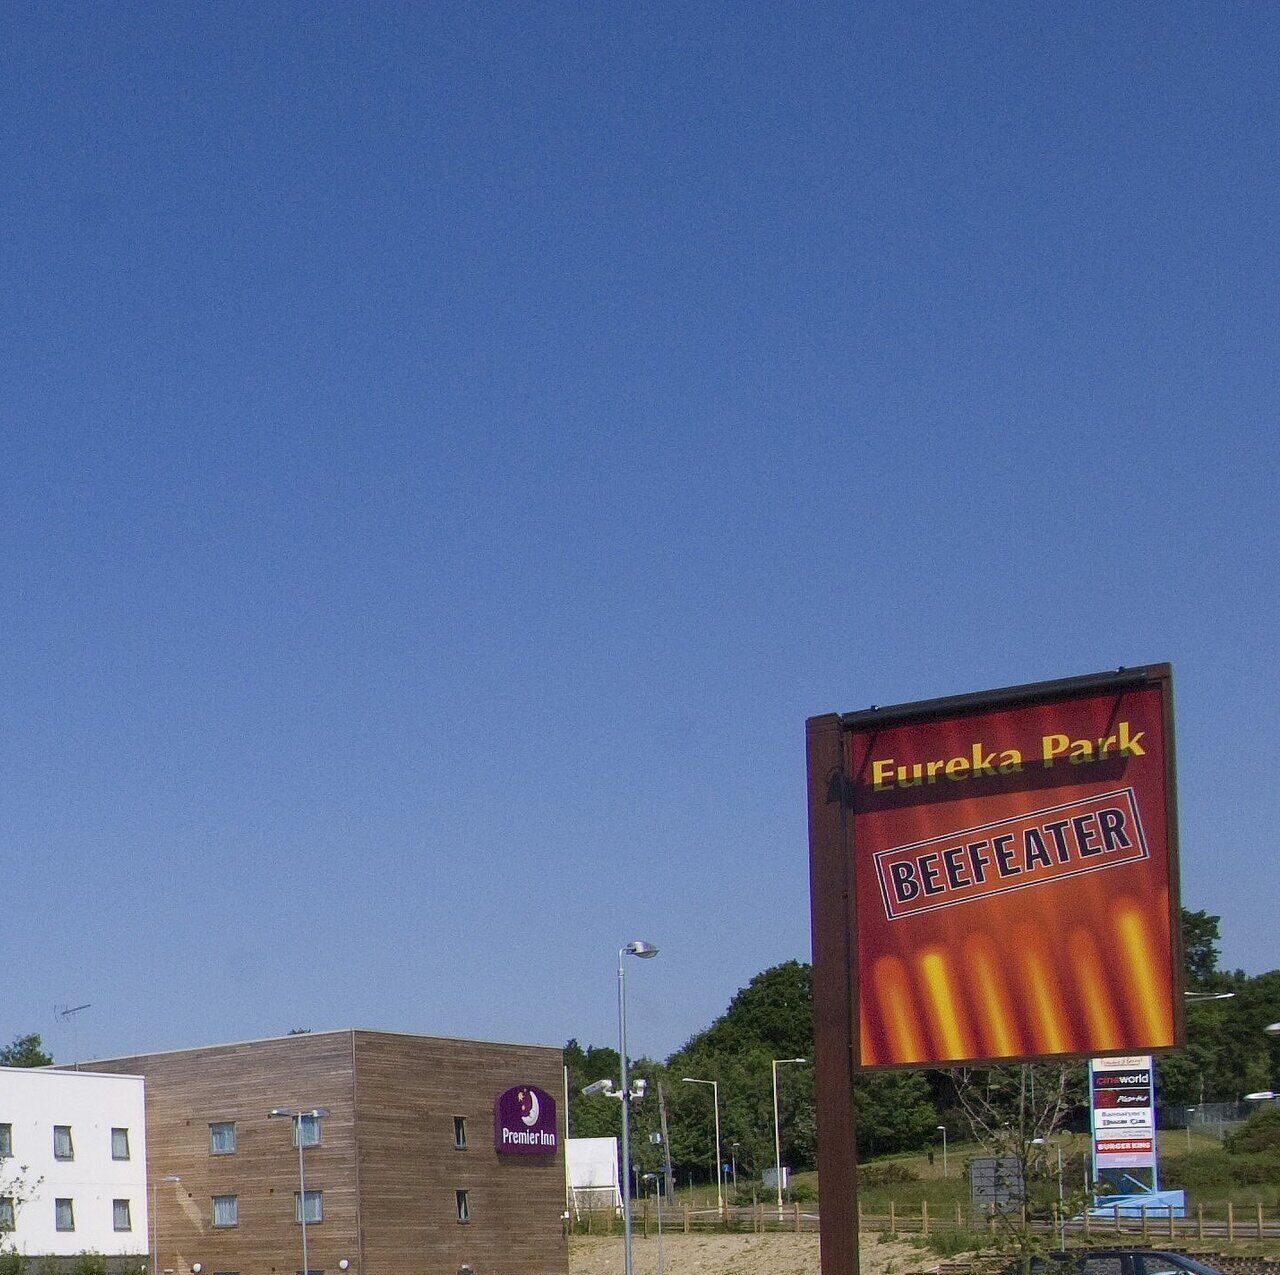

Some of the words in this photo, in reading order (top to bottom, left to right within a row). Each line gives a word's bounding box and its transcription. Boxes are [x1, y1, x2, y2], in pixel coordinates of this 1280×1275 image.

[872, 743, 1023, 792] Eureka
[1042, 722, 1146, 769] Park
[889, 807, 1133, 904] BEEFEATER
[1096, 1073, 1149, 1085] cineworld
[502, 1127, 540, 1145] Premier
[540, 1129, 556, 1146] Inn
